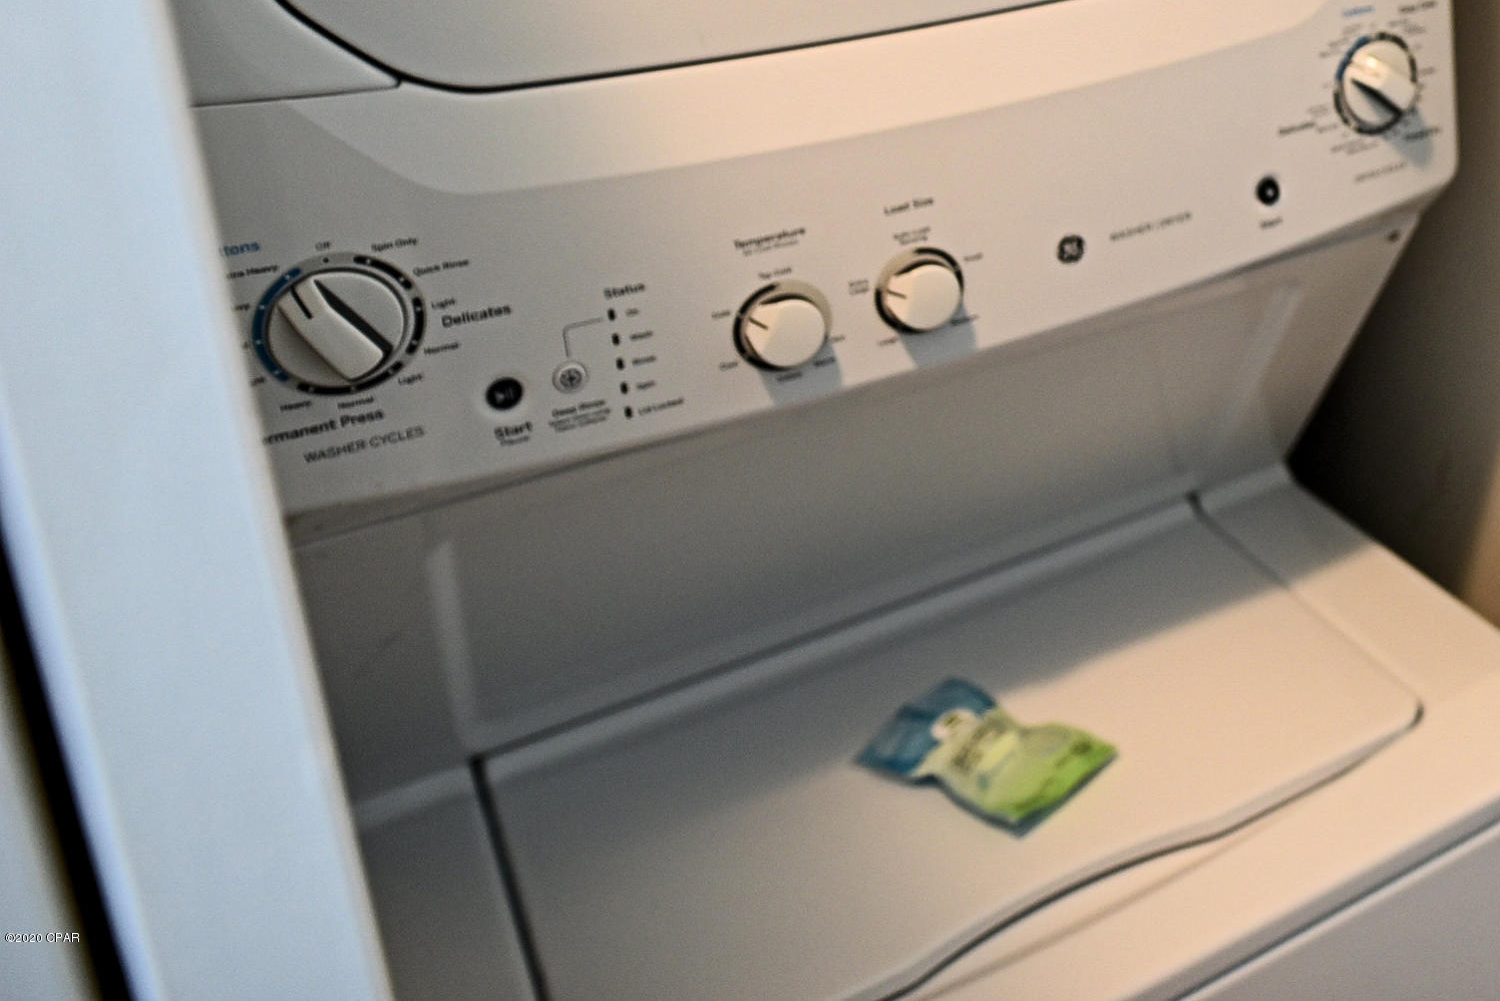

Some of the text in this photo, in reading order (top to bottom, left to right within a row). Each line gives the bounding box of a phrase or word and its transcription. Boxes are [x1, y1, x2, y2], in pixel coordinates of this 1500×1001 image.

[442, 305, 512, 328] Delicates
[340, 409, 384, 428] Press
[494, 421, 533, 439] Start
[304, 425, 425, 463] WASHER CYCLES
